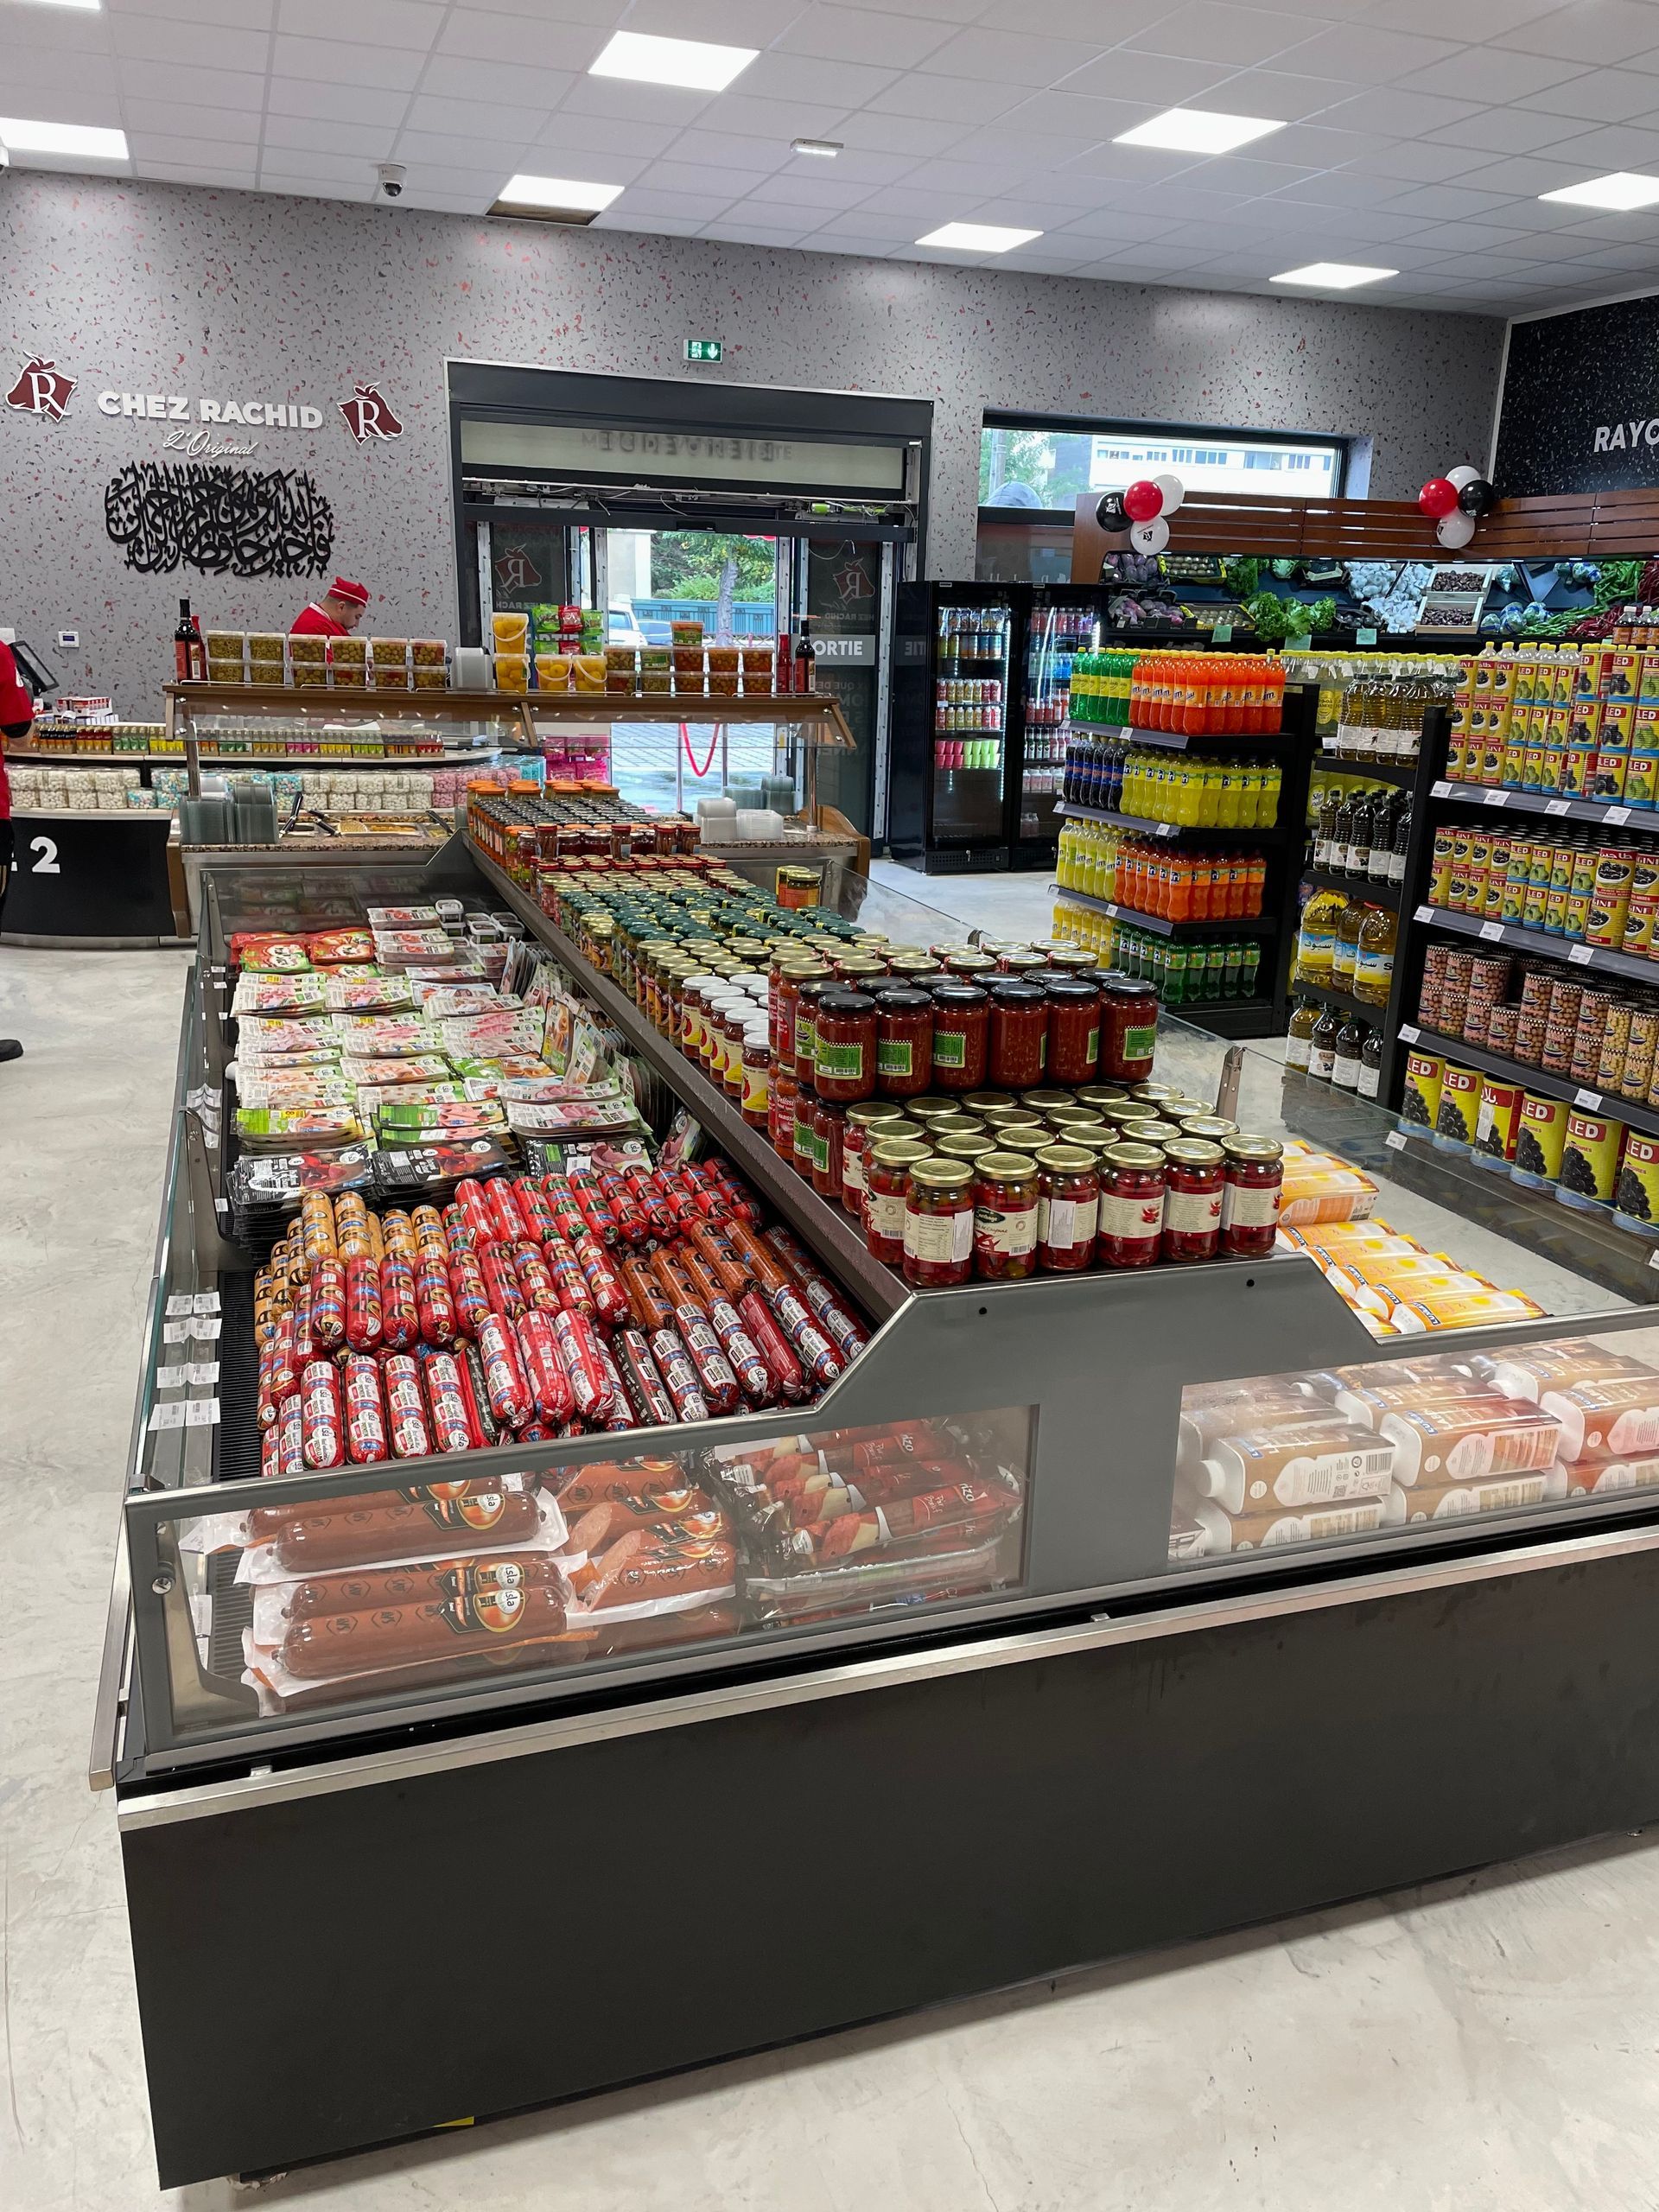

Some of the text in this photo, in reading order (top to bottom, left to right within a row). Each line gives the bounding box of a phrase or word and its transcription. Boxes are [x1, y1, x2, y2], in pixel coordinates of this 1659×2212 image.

[97, 391, 323, 429] CHEZ RACHID
[162, 430, 259, 457] L'Original
[1594, 418, 1659, 453] RAYO
[812, 640, 862, 656] ORTIE
[30, 836, 60, 874] 2
[1408, 1057, 1432, 1075] LED
[1444, 1071, 1470, 1089] LED
[1522, 1099, 1548, 1119] LED
[1567, 1116, 1599, 1139] LED
[1626, 1136, 1654, 1160] LED
